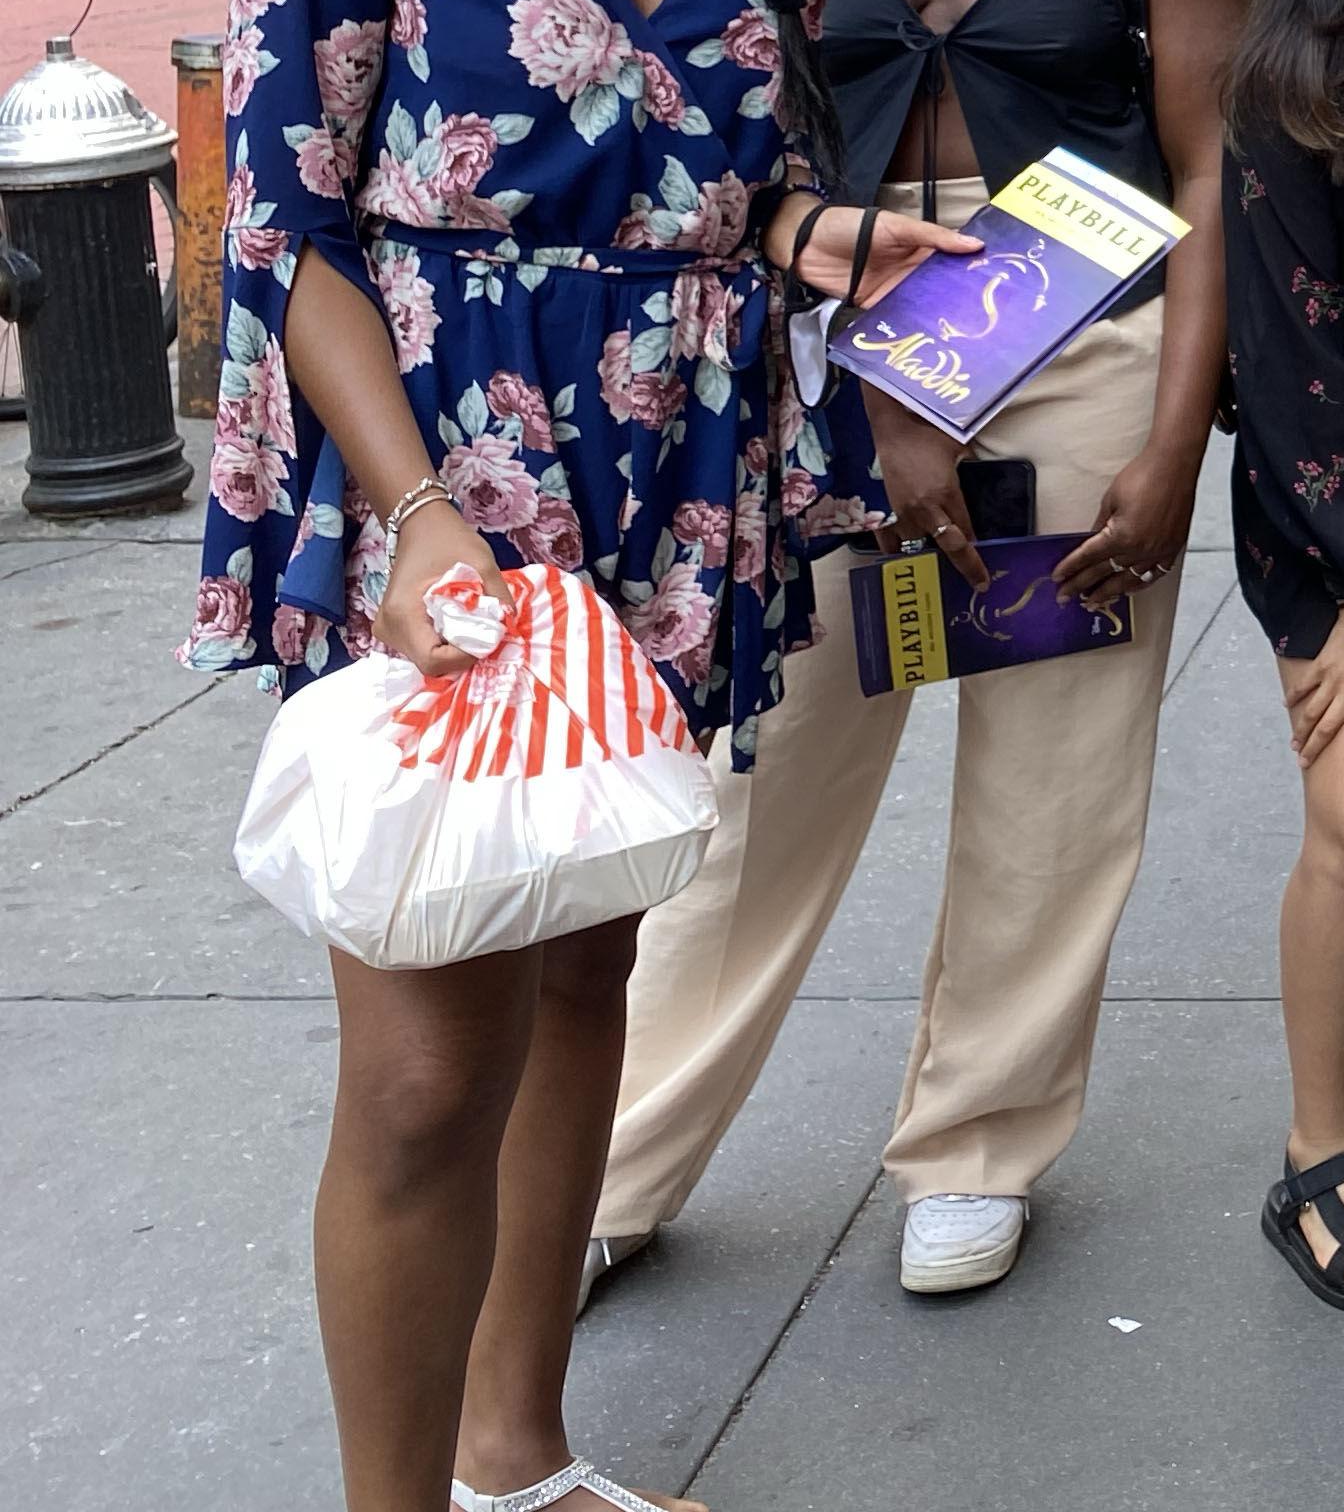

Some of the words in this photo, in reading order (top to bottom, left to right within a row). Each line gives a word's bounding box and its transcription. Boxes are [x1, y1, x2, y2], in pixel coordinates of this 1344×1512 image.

[1017, 174, 1146, 257] PLAYBILL
[852, 332, 972, 405] Aladdin
[894, 564, 927, 685] PLAYBILL
